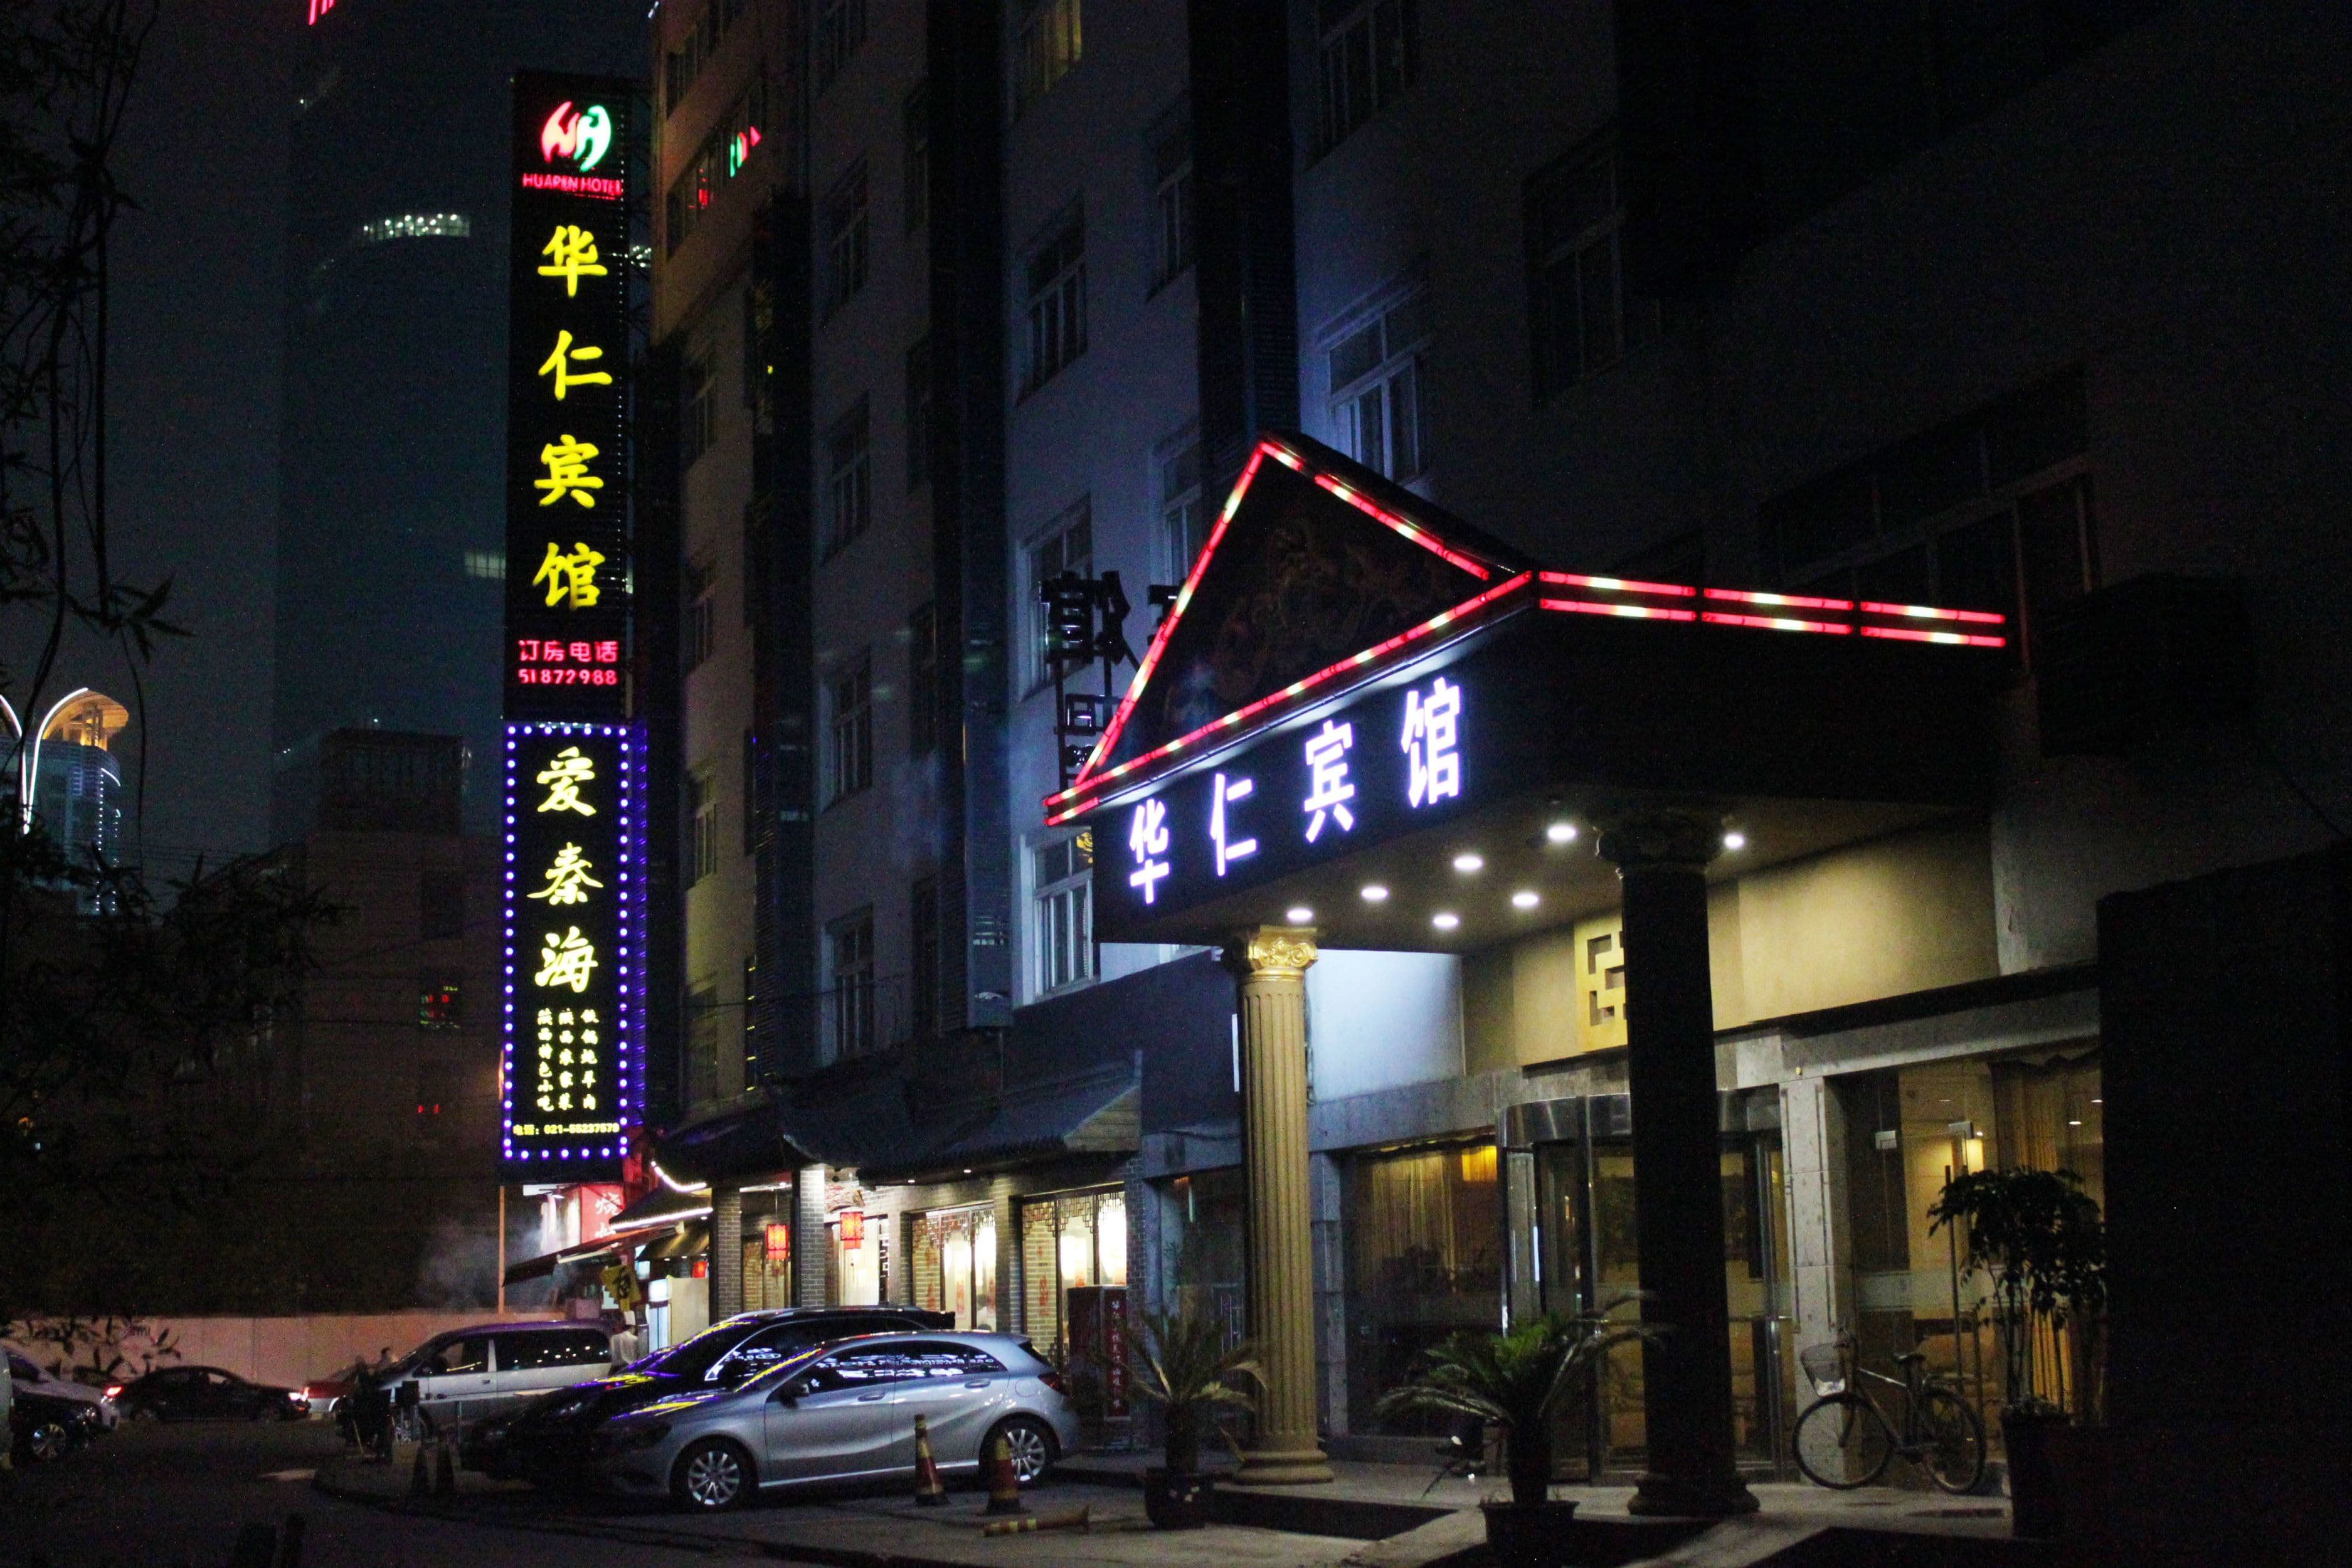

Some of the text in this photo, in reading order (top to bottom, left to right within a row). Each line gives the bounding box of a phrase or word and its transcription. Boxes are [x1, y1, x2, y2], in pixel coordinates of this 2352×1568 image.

[533, 225, 613, 610] 华仁宾馆
[518, 640, 618, 663] 订房电话
[518, 669, 618, 686] 51872988
[1130, 677, 1461, 904] 华仁宾馆
